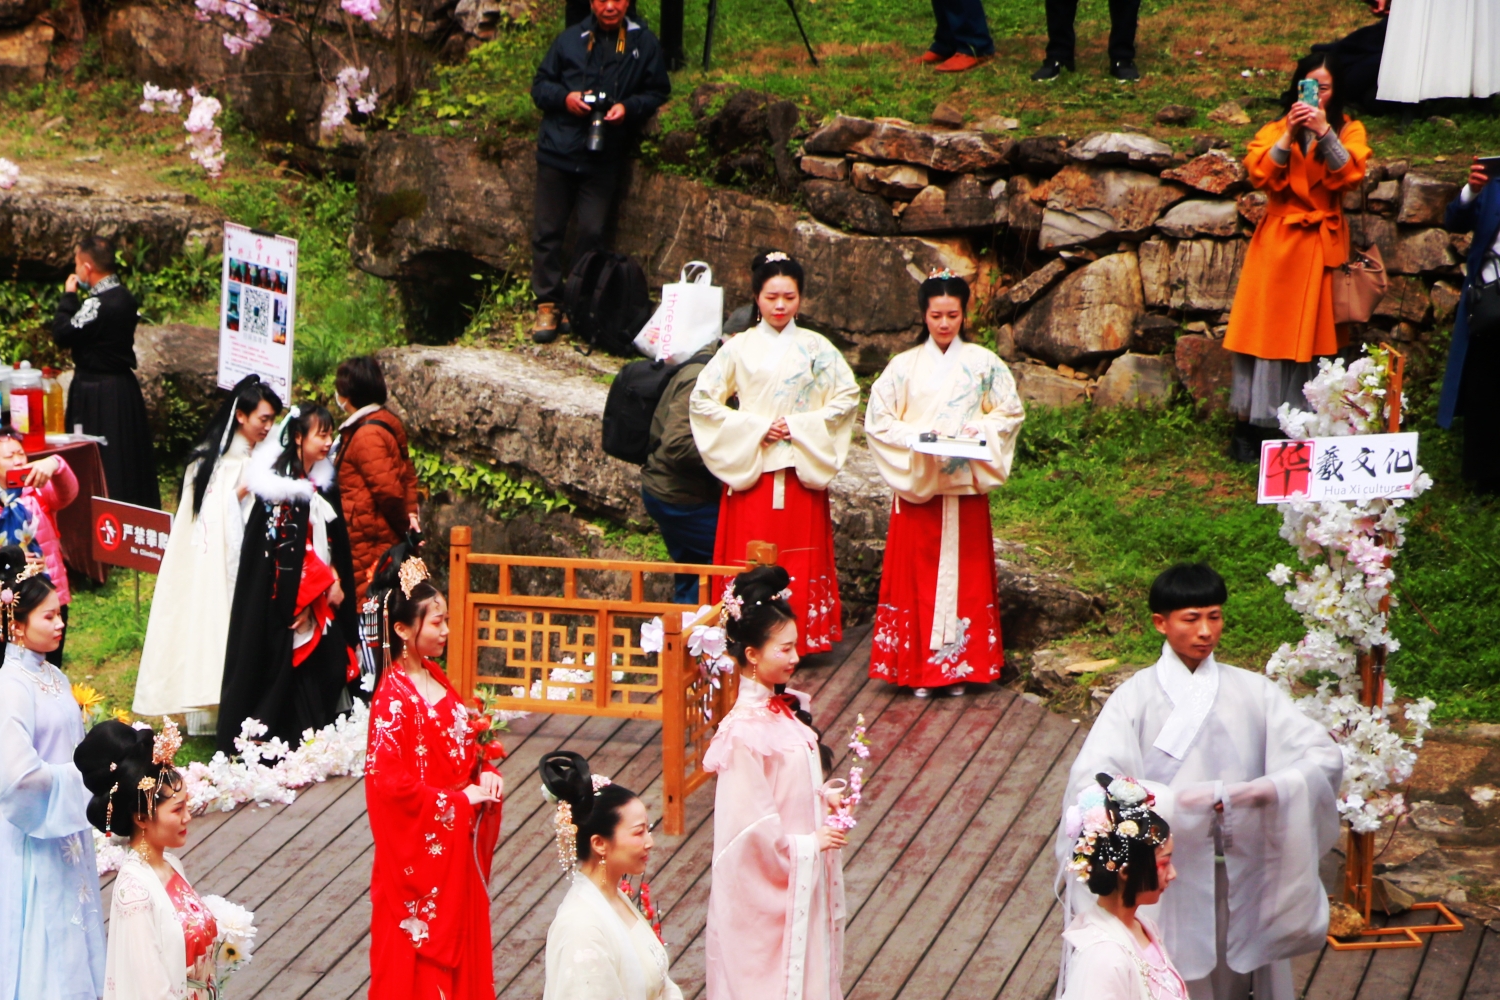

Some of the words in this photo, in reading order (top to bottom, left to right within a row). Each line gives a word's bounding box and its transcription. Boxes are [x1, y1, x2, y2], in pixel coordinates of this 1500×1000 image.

[1324, 485, 1346, 495] Hua
[1349, 484, 1361, 494] Xi
[1363, 483, 1403, 495] culture
